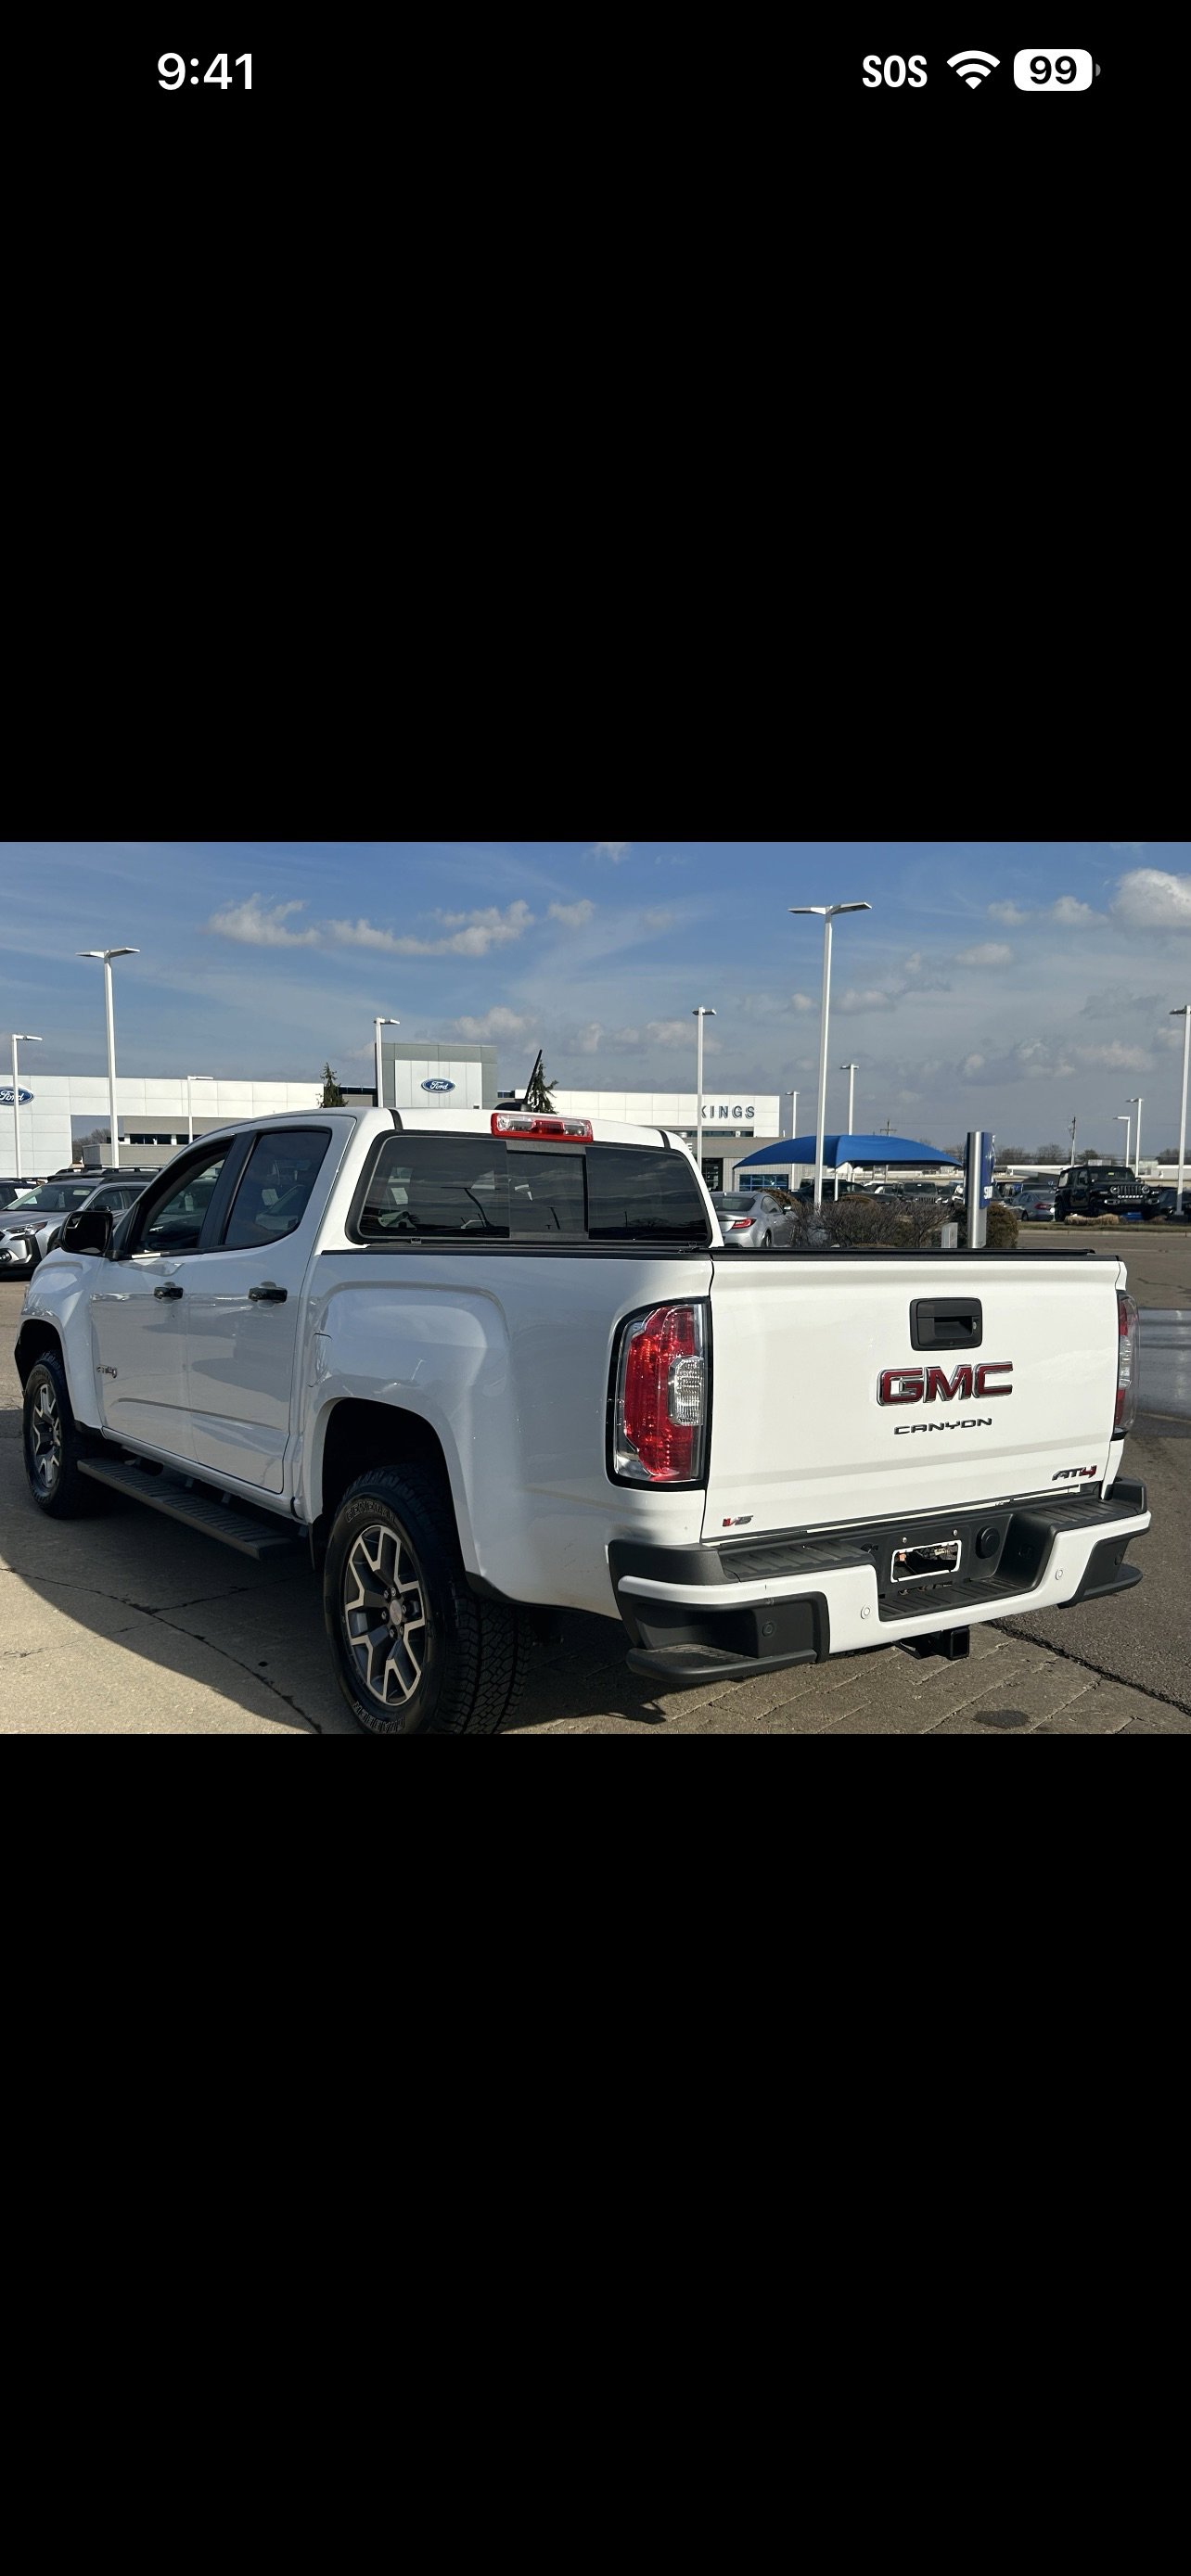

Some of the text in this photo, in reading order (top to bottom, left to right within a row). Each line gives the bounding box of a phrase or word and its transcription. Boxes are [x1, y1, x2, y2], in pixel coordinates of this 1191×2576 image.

[429, 1081, 449, 1090] Ford
[877, 1360, 1014, 1407] GMC
[893, 1417, 993, 1435] CANYON
[1051, 1464, 1098, 1482] AT4
